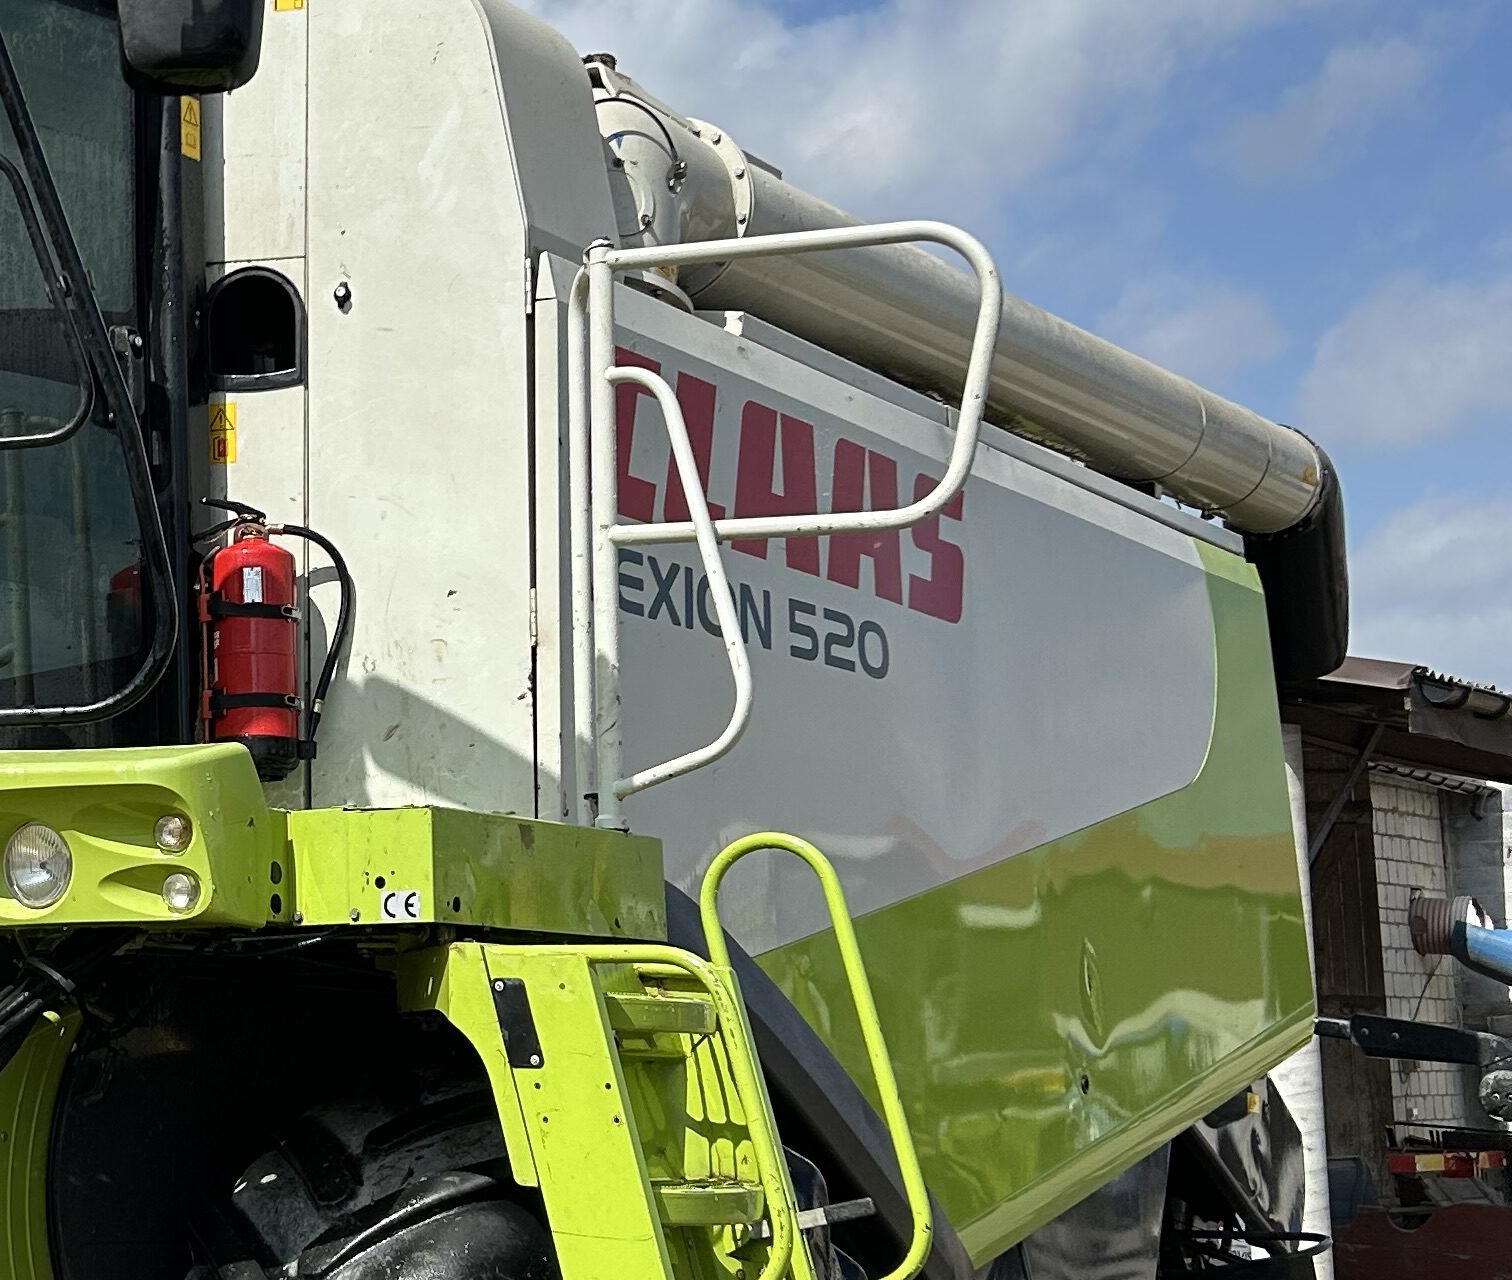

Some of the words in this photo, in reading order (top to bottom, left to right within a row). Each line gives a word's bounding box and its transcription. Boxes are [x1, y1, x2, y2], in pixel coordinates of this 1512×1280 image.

[616, 346, 964, 624] CLAAS
[619, 548, 772, 650] EXION
[789, 598, 889, 679] 520
[384, 892, 417, 918] CE
